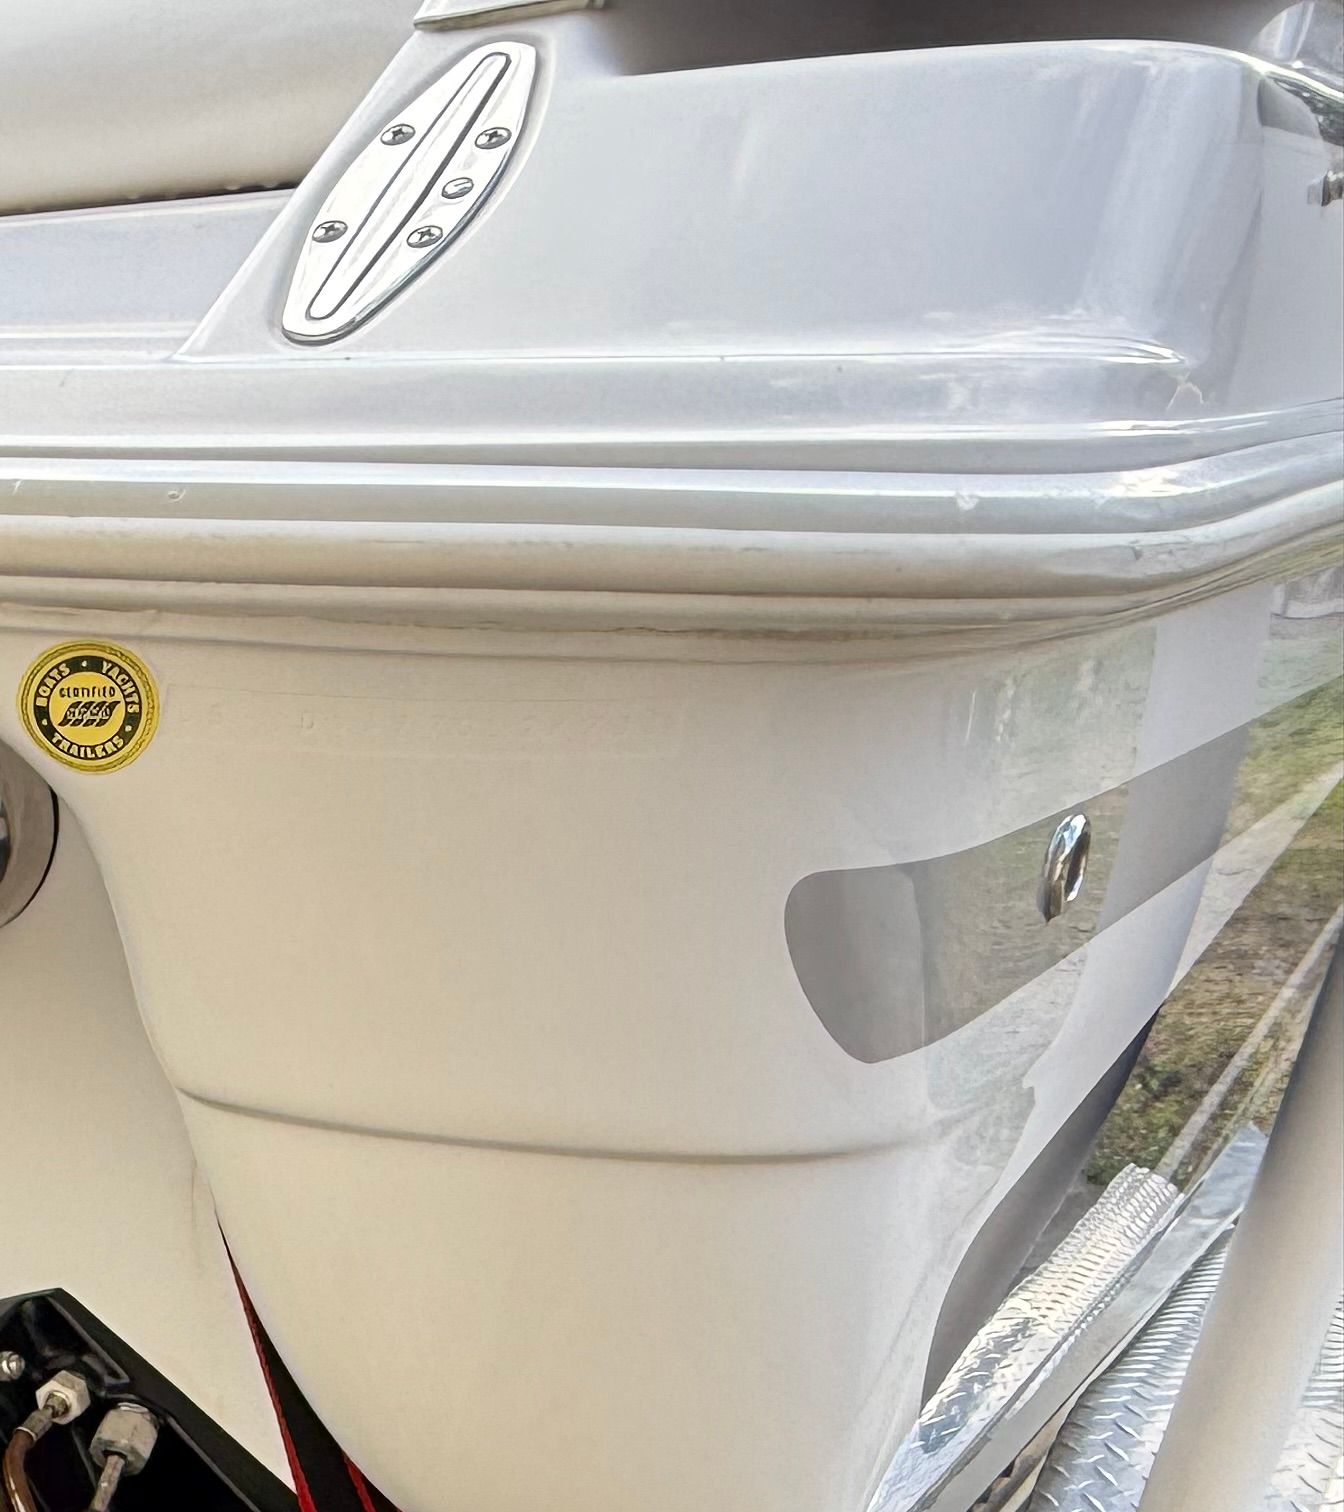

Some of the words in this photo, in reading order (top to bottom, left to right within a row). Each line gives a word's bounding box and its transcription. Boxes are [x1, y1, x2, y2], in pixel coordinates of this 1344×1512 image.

[35, 662, 71, 707] BOATS
[101, 660, 140, 713] YACHTS
[51, 732, 124, 758] TRAILERS
